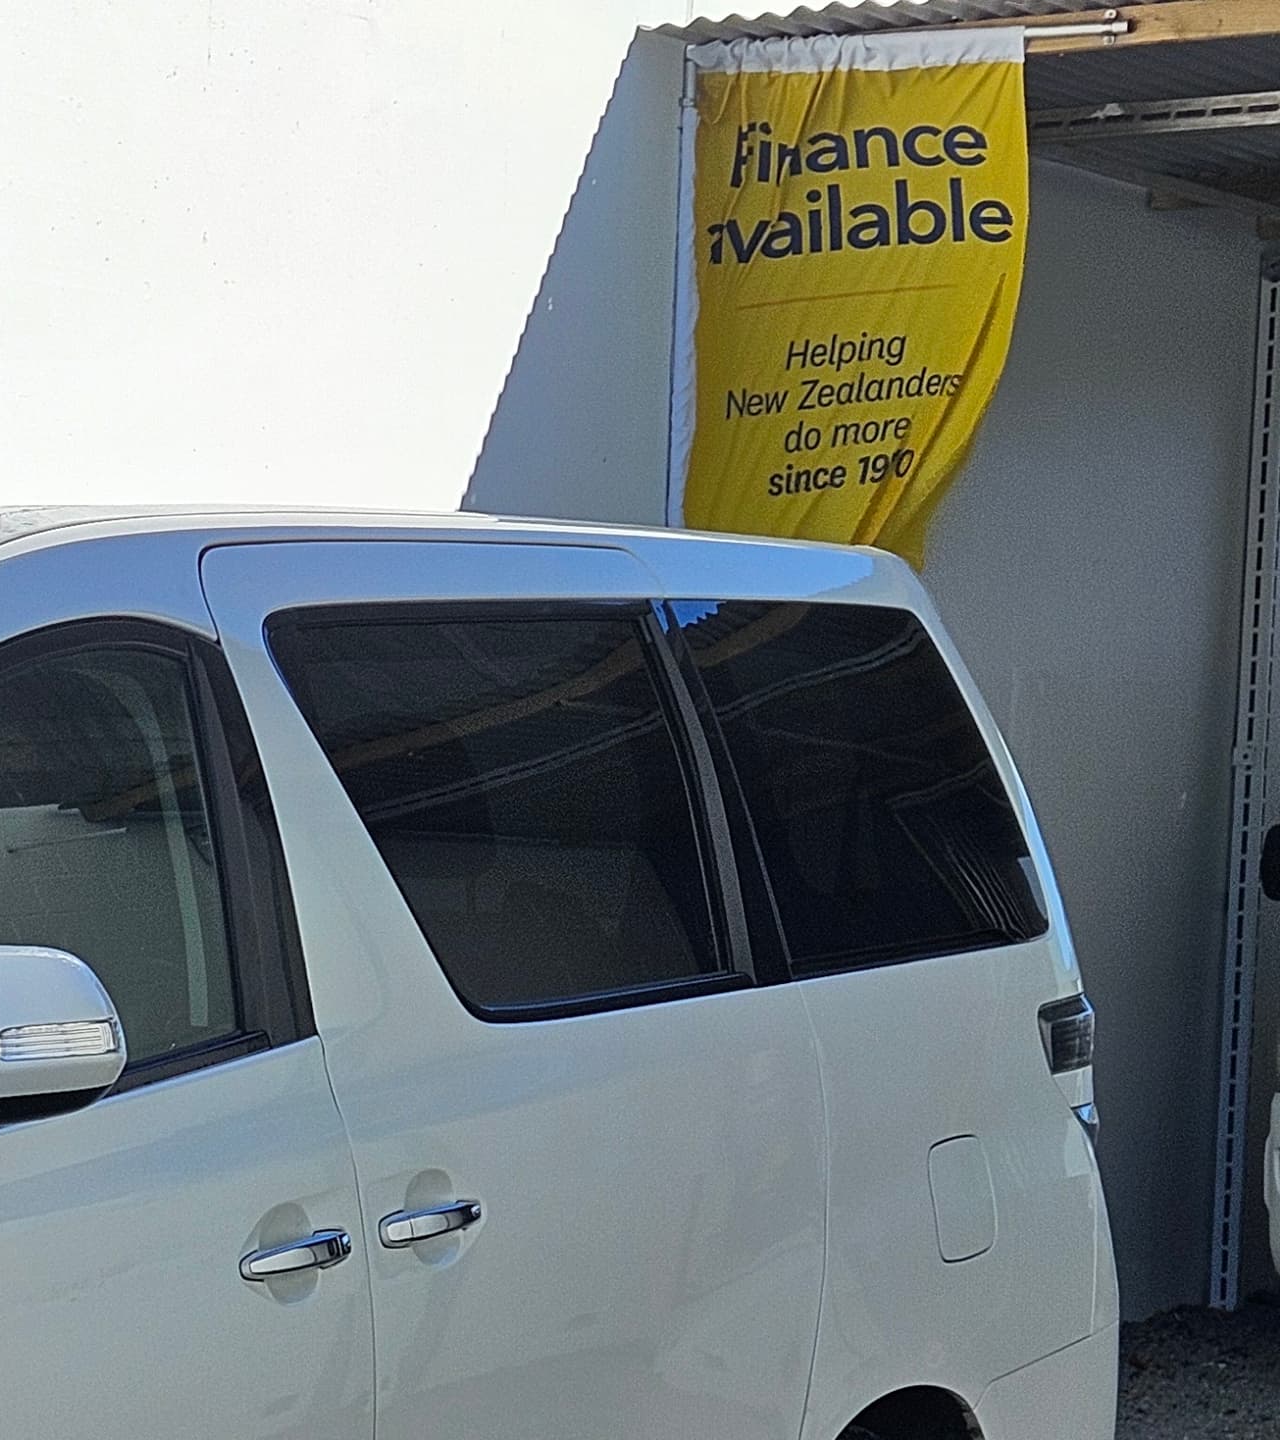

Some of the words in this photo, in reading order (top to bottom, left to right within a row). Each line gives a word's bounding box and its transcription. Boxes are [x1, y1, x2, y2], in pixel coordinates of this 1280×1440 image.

[730, 121, 988, 188] Finance
[785, 333, 907, 372] Helping
[726, 388, 788, 420] New
[797, 366, 963, 411] Zealanders
[784, 420, 822, 453] do
[832, 414, 912, 448] more
[768, 463, 847, 497] since
[858, 448, 915, 485] 190
